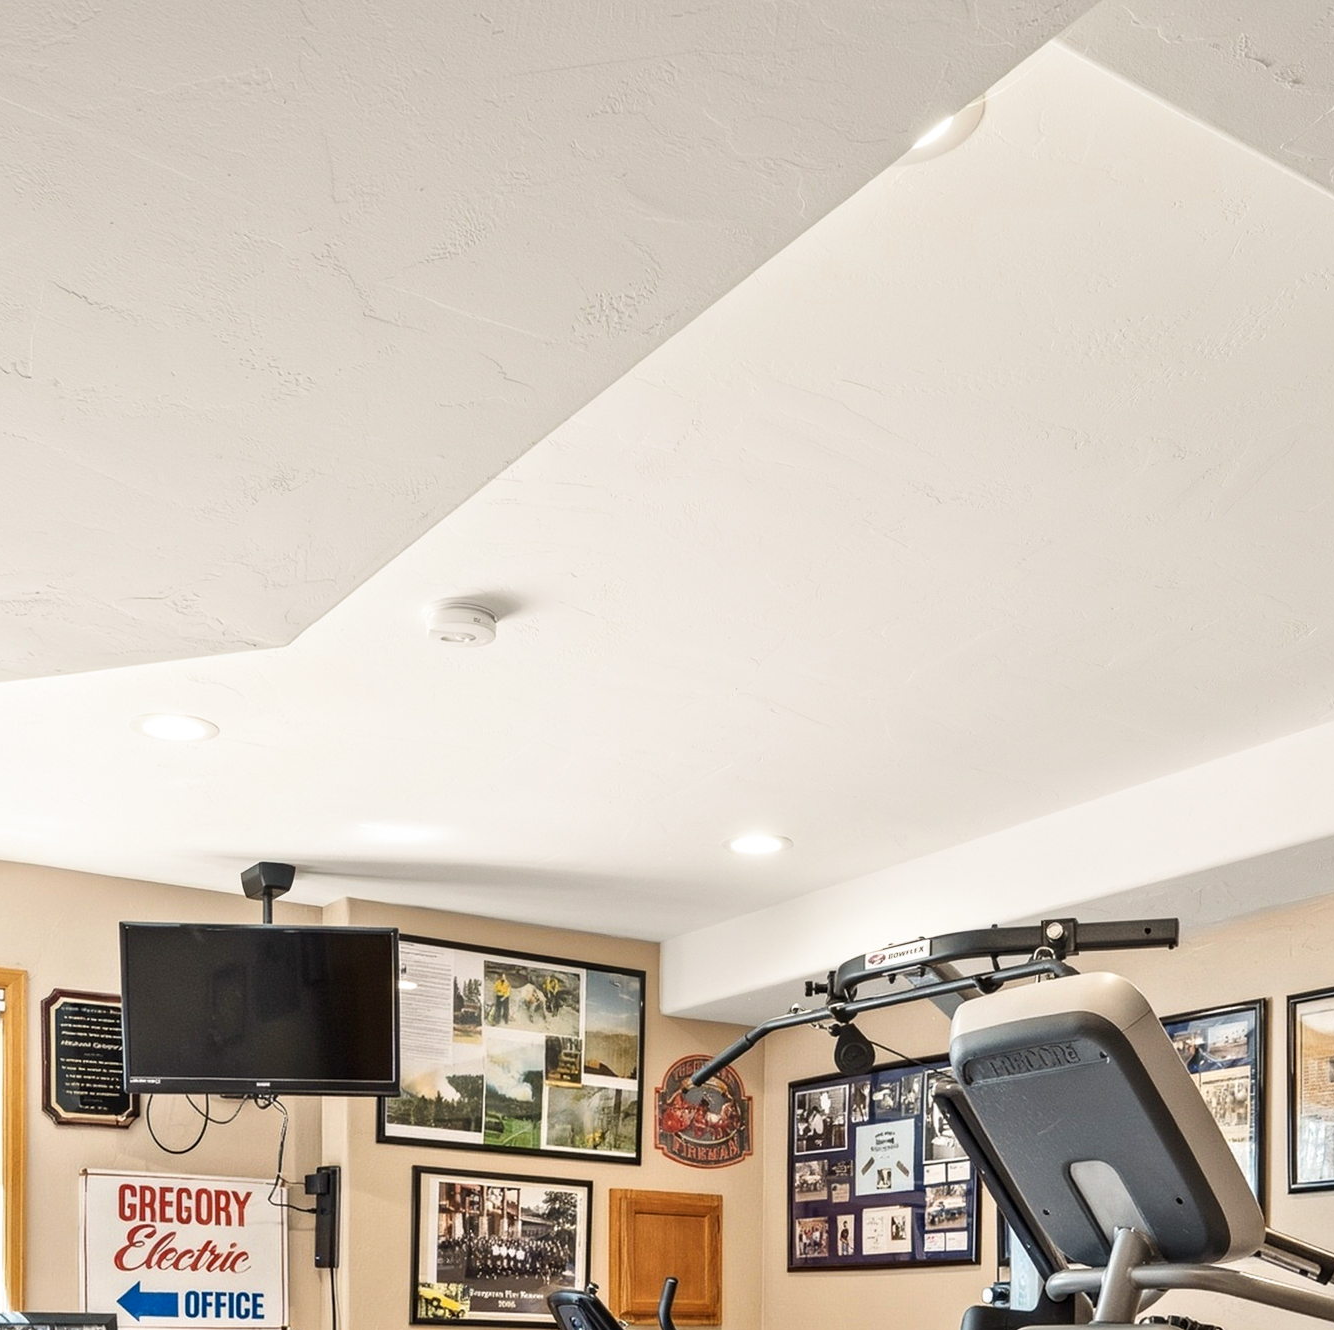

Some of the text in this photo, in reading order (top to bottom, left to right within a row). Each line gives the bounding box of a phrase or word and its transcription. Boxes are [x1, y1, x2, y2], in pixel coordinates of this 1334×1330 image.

[888, 946, 925, 960] BOWFLEX
[672, 1138, 739, 1161] FIREMAN
[118, 1184, 253, 1227] GREGORY
[114, 1224, 252, 1274] Electric
[185, 1290, 265, 1319] OFFICE
